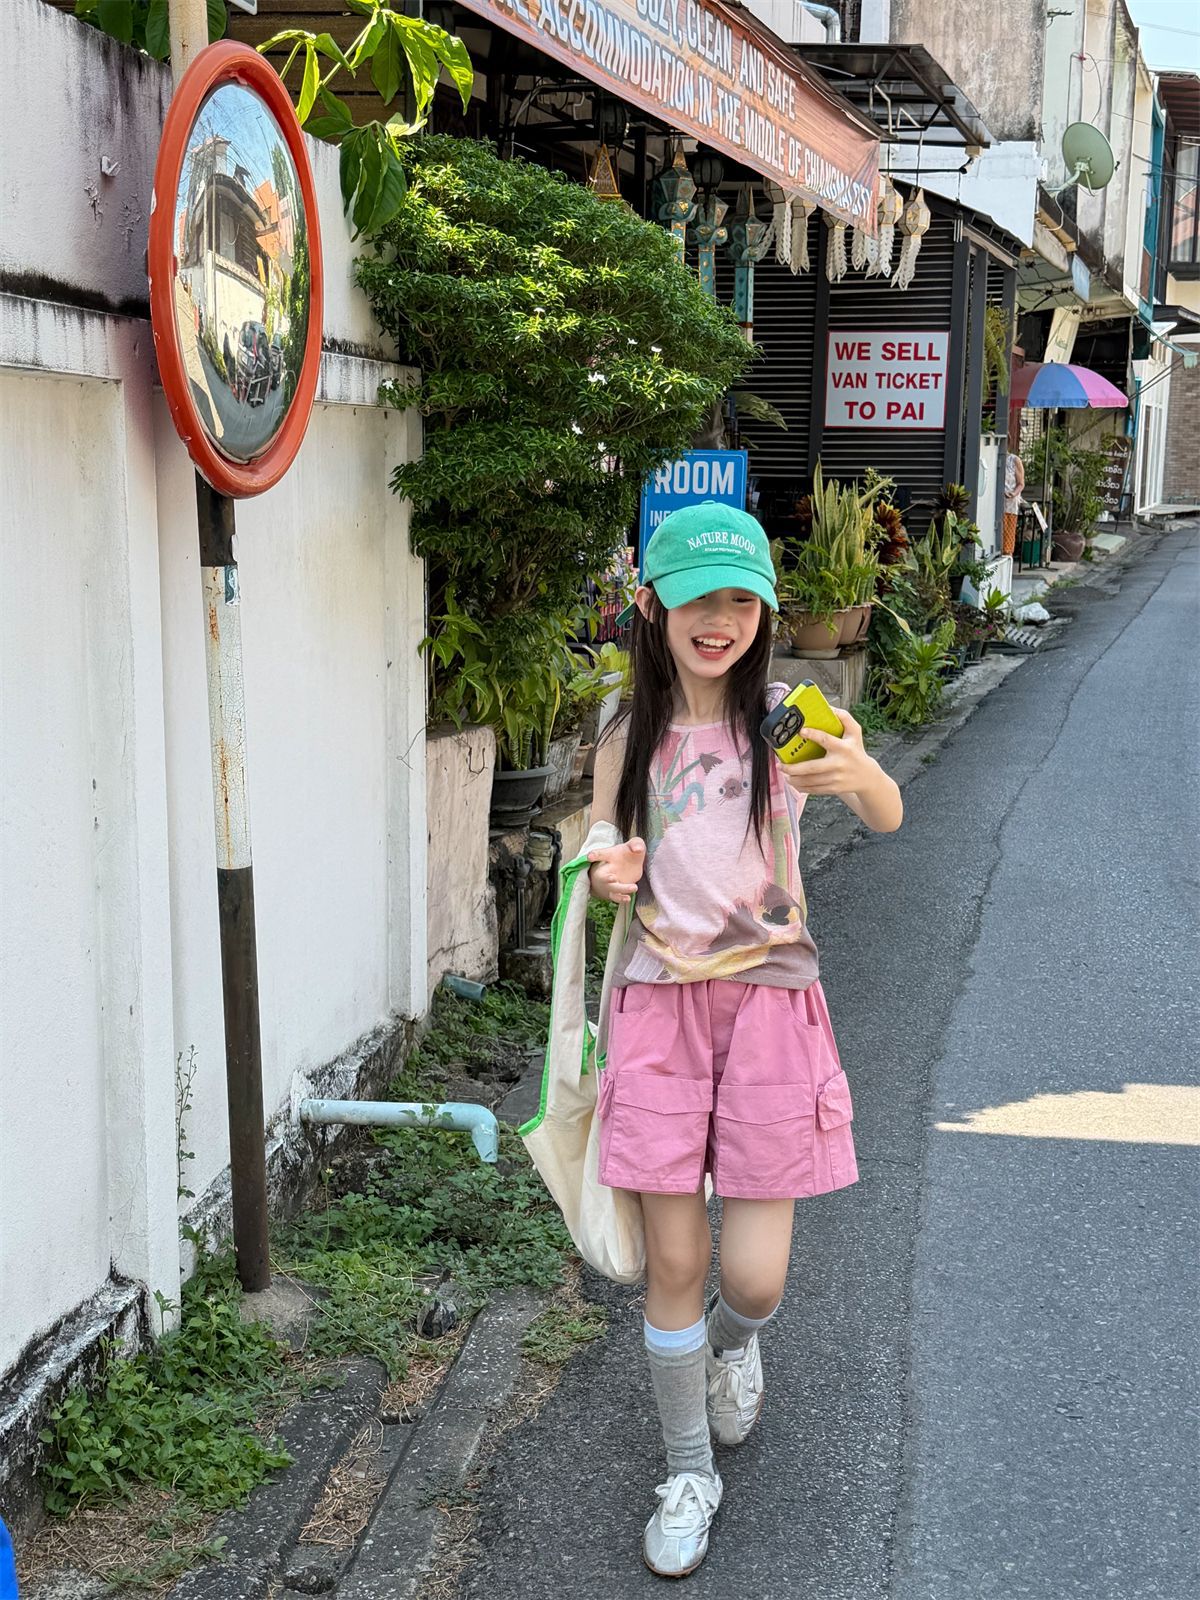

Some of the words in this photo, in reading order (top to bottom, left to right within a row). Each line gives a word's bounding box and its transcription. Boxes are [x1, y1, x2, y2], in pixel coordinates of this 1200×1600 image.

[687, 0, 736, 82] CLEAN,
[739, 40, 765, 98] AND
[767, 60, 796, 121] SAFE
[537, 0, 694, 118] ACCOMMODATION
[698, 75, 713, 129] IN
[716, 87, 741, 144] THE
[744, 108, 785, 173] MIDDLE
[788, 136, 802, 179] OF
[834, 342, 872, 361] WE
[880, 342, 941, 361] SELL
[831, 372, 868, 389] VAN
[875, 372, 943, 389] TICKET
[844, 401, 876, 420] TO
[886, 401, 925, 421] PAI
[654, 459, 735, 495] ROOM
[686, 531, 729, 552] NATURE
[730, 532, 756, 556] MOOD
[790, 738, 808, 756] Hel
